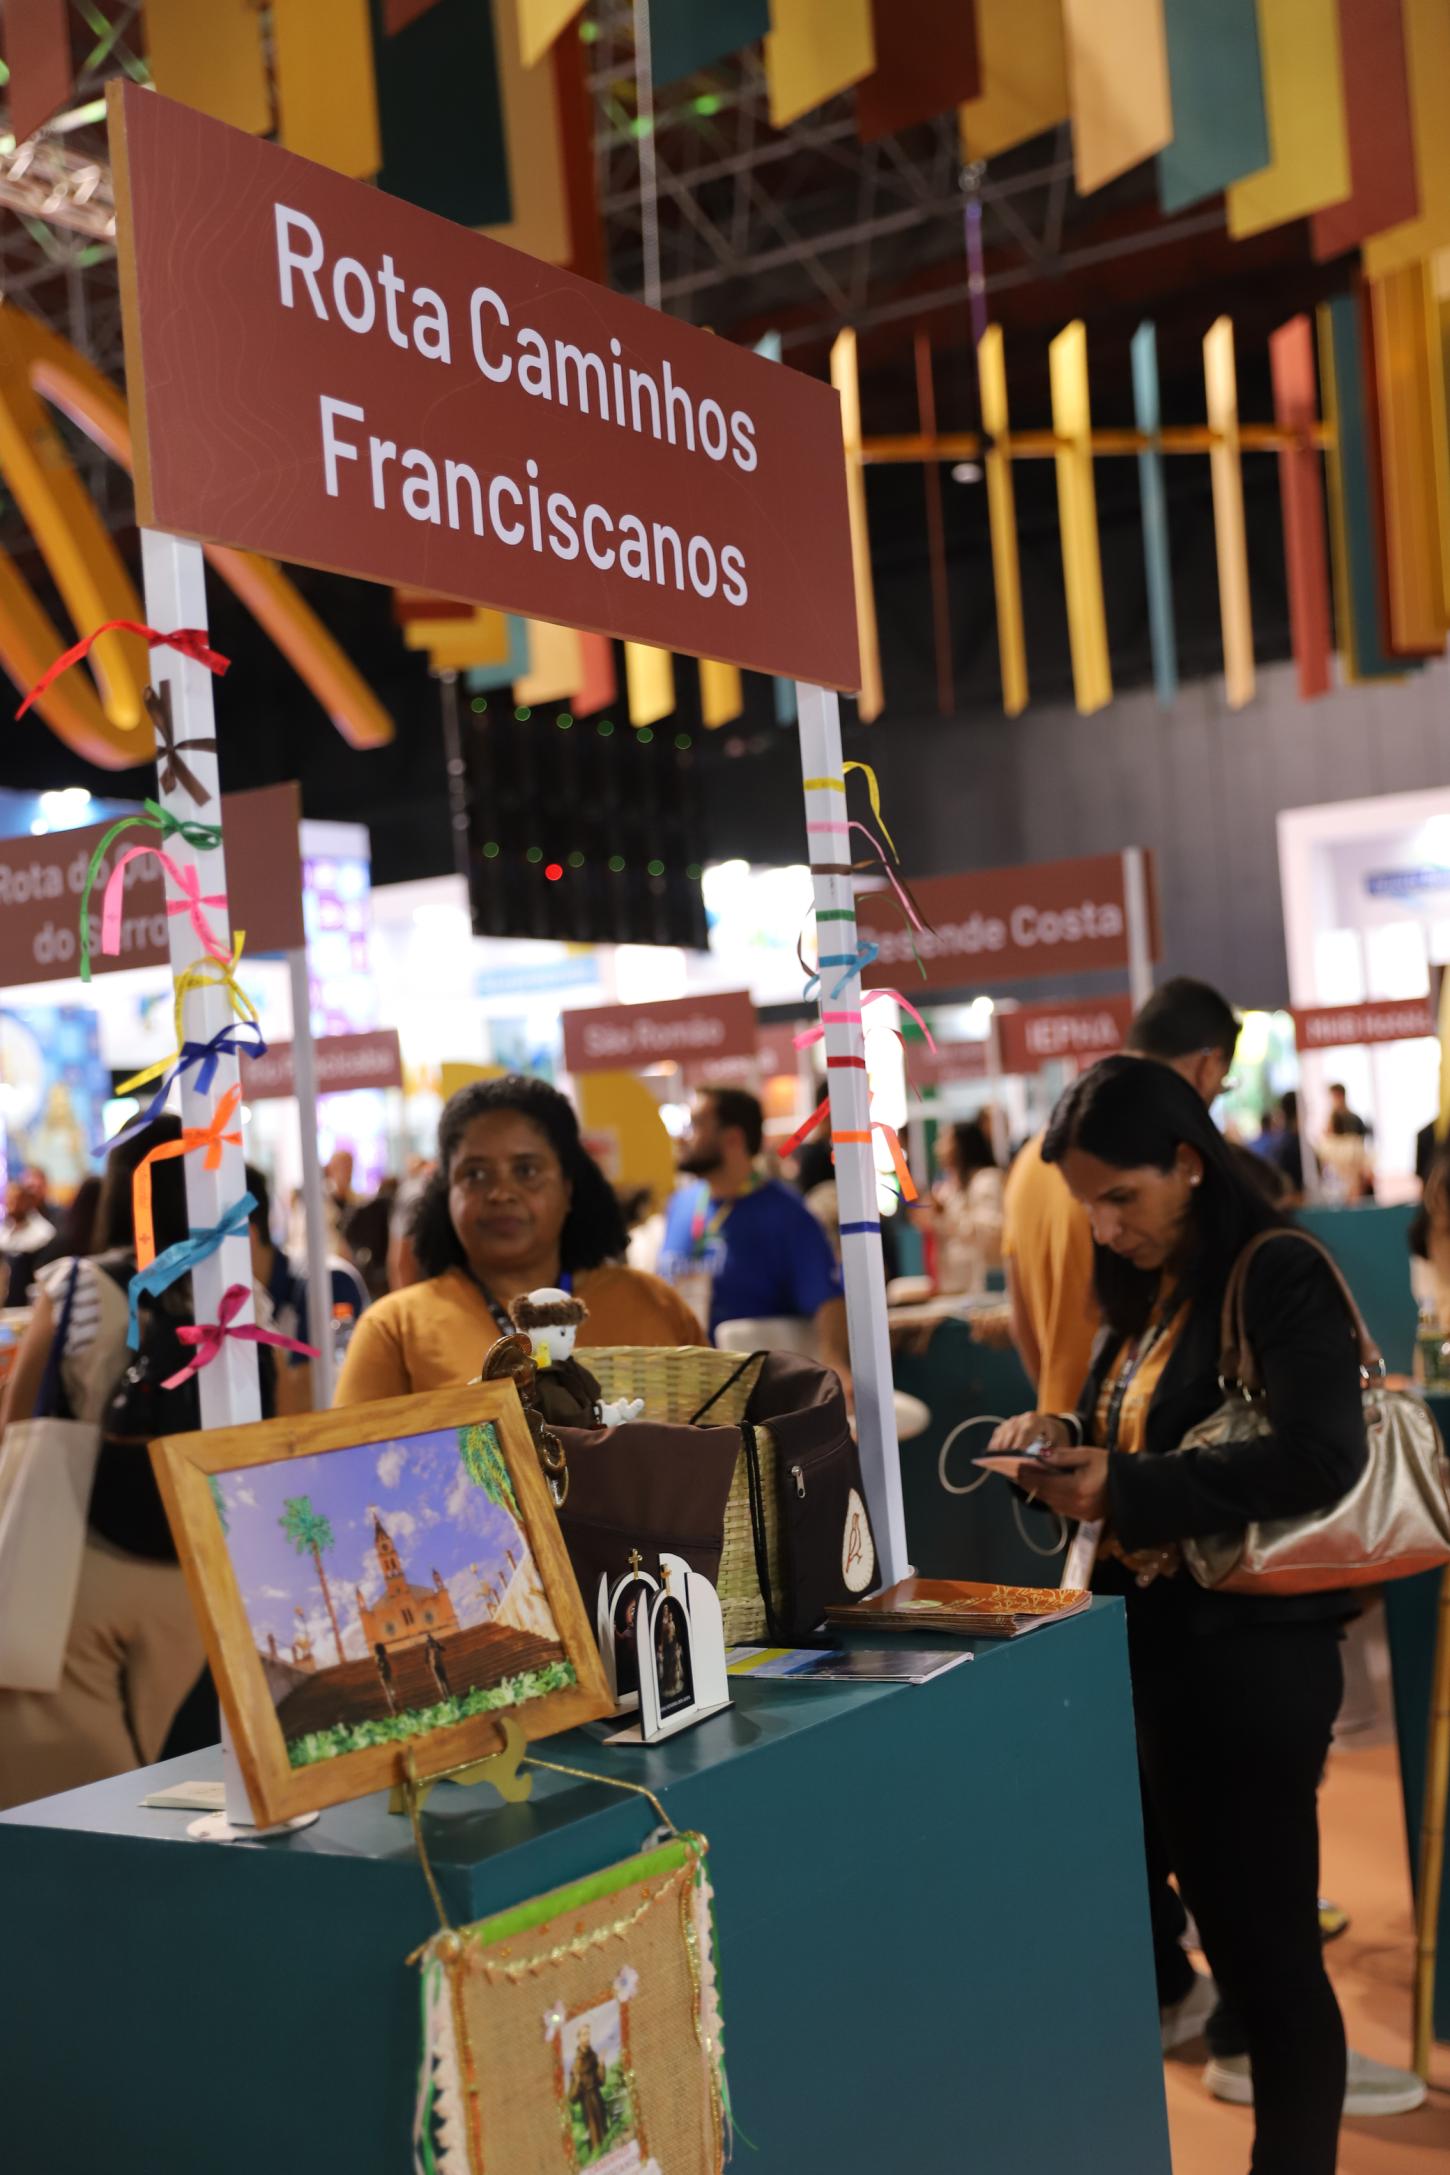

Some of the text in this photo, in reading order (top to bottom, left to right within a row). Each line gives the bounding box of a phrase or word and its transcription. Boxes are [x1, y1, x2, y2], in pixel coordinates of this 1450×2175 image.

[275, 203, 758, 472] Rota Caminhos
[320, 394, 748, 606] Franciscanos
[33, 912, 170, 965] do Srro
[1010, 900, 1124, 947] Costa
